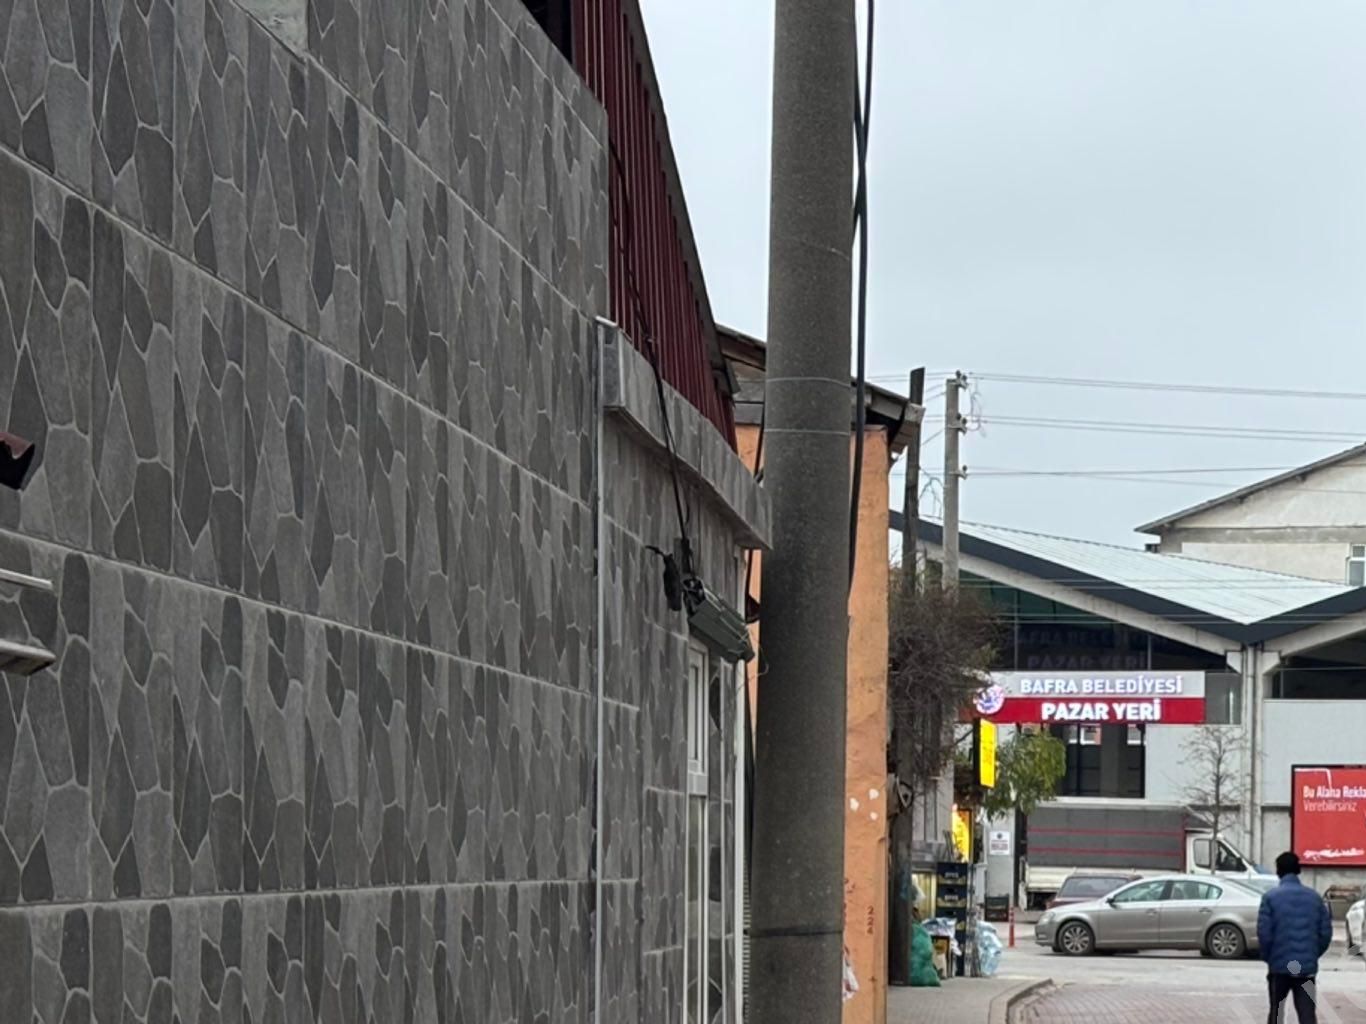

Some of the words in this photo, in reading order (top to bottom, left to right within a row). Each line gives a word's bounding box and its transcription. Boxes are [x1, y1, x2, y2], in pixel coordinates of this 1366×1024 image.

[1020, 678, 1079, 693] BAFRA
[1082, 675, 1182, 693] BELEDİYESİ
[1041, 703, 1109, 720] PAZAR
[1112, 698, 1162, 720] YERİ
[1303, 786, 1315, 798] Bu
[1303, 800, 1357, 812] Verebilirsiniz
